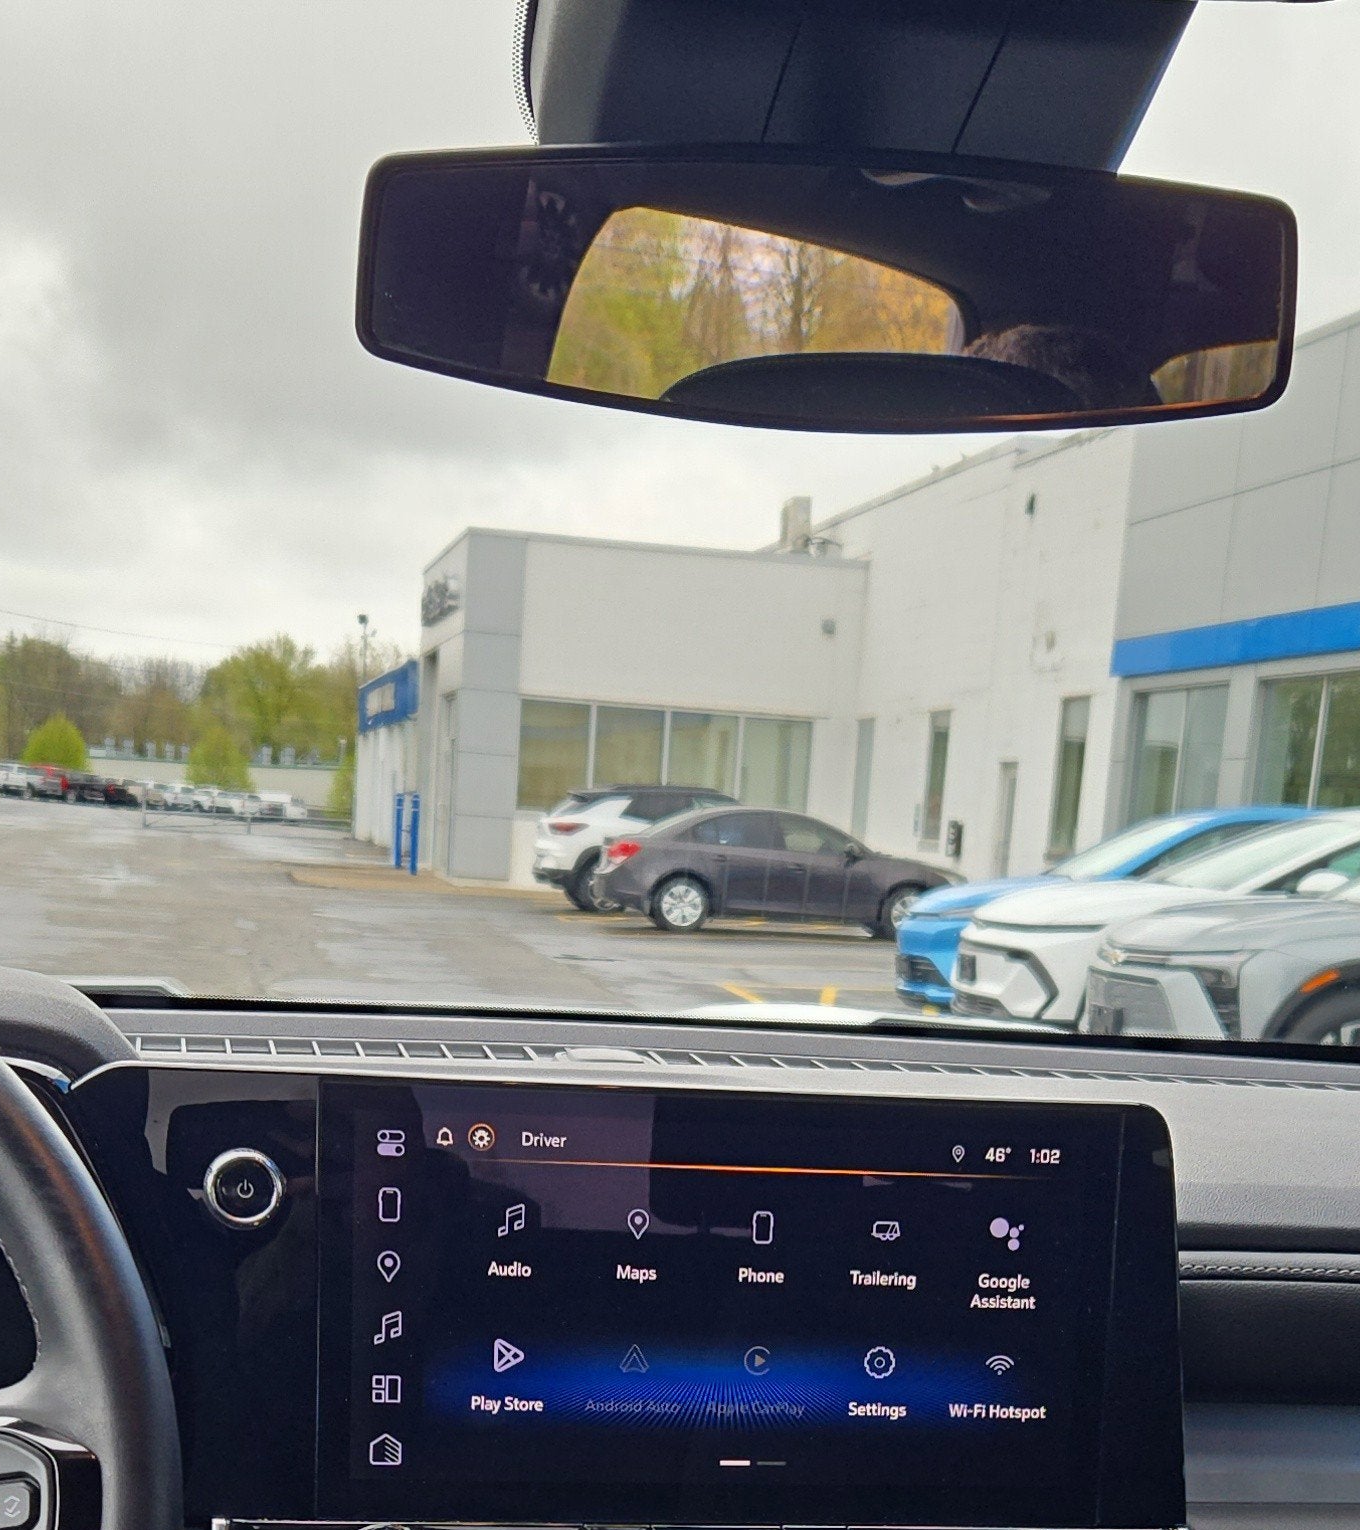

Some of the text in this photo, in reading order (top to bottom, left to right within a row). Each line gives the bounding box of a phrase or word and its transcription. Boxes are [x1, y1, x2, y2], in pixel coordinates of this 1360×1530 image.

[521, 1131, 568, 1148] Driver
[985, 1147, 1061, 1164] 46° 1:02
[487, 1261, 532, 1277] Audio
[616, 1264, 657, 1283] Maps
[738, 1267, 785, 1284] Phone
[849, 1270, 917, 1290] Trailering
[978, 1273, 1031, 1292] Google
[970, 1293, 1036, 1309] Assistant
[470, 1395, 544, 1415] Play Store
[848, 1401, 908, 1420] Settings
[948, 1403, 1047, 1423] Wi-Fi Hotspot
